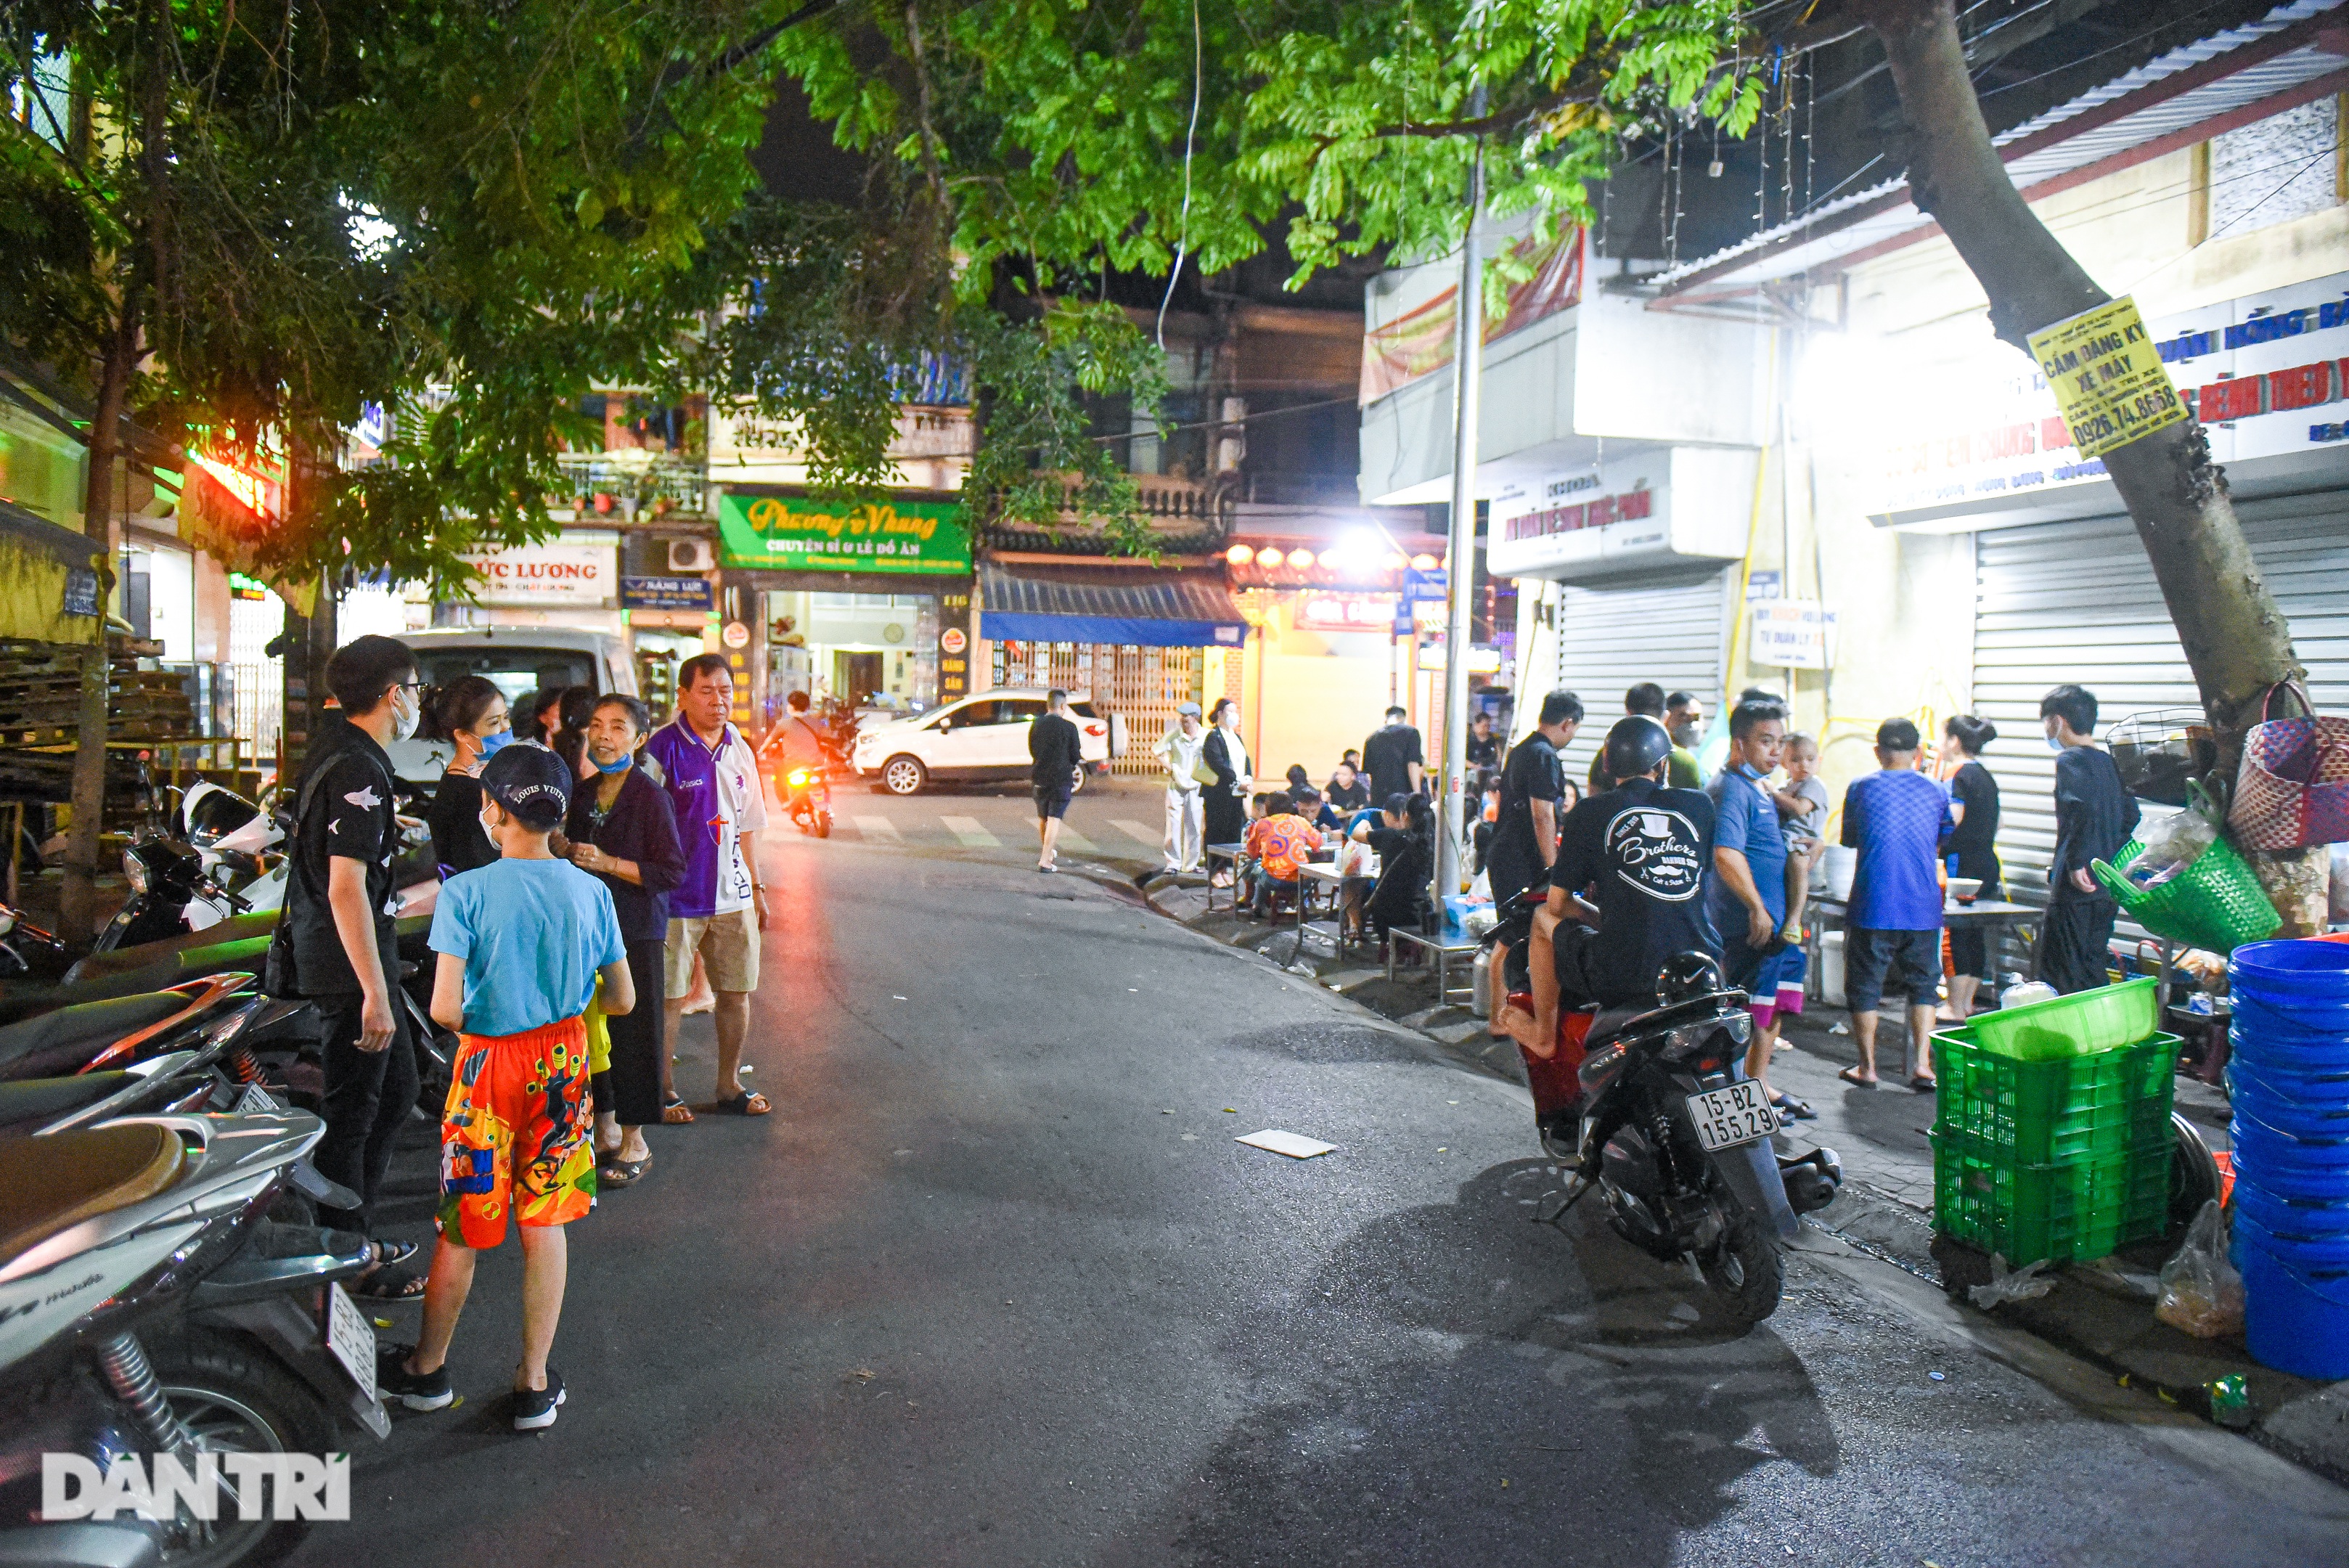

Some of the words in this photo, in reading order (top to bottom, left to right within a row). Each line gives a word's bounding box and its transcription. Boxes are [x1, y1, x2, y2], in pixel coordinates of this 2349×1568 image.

[514, 785, 539, 804] LOUIS
[1617, 836, 1696, 864] Brothers
[1700, 1085, 1757, 1118] 15-B2
[1703, 1108, 1773, 1145] 155.29
